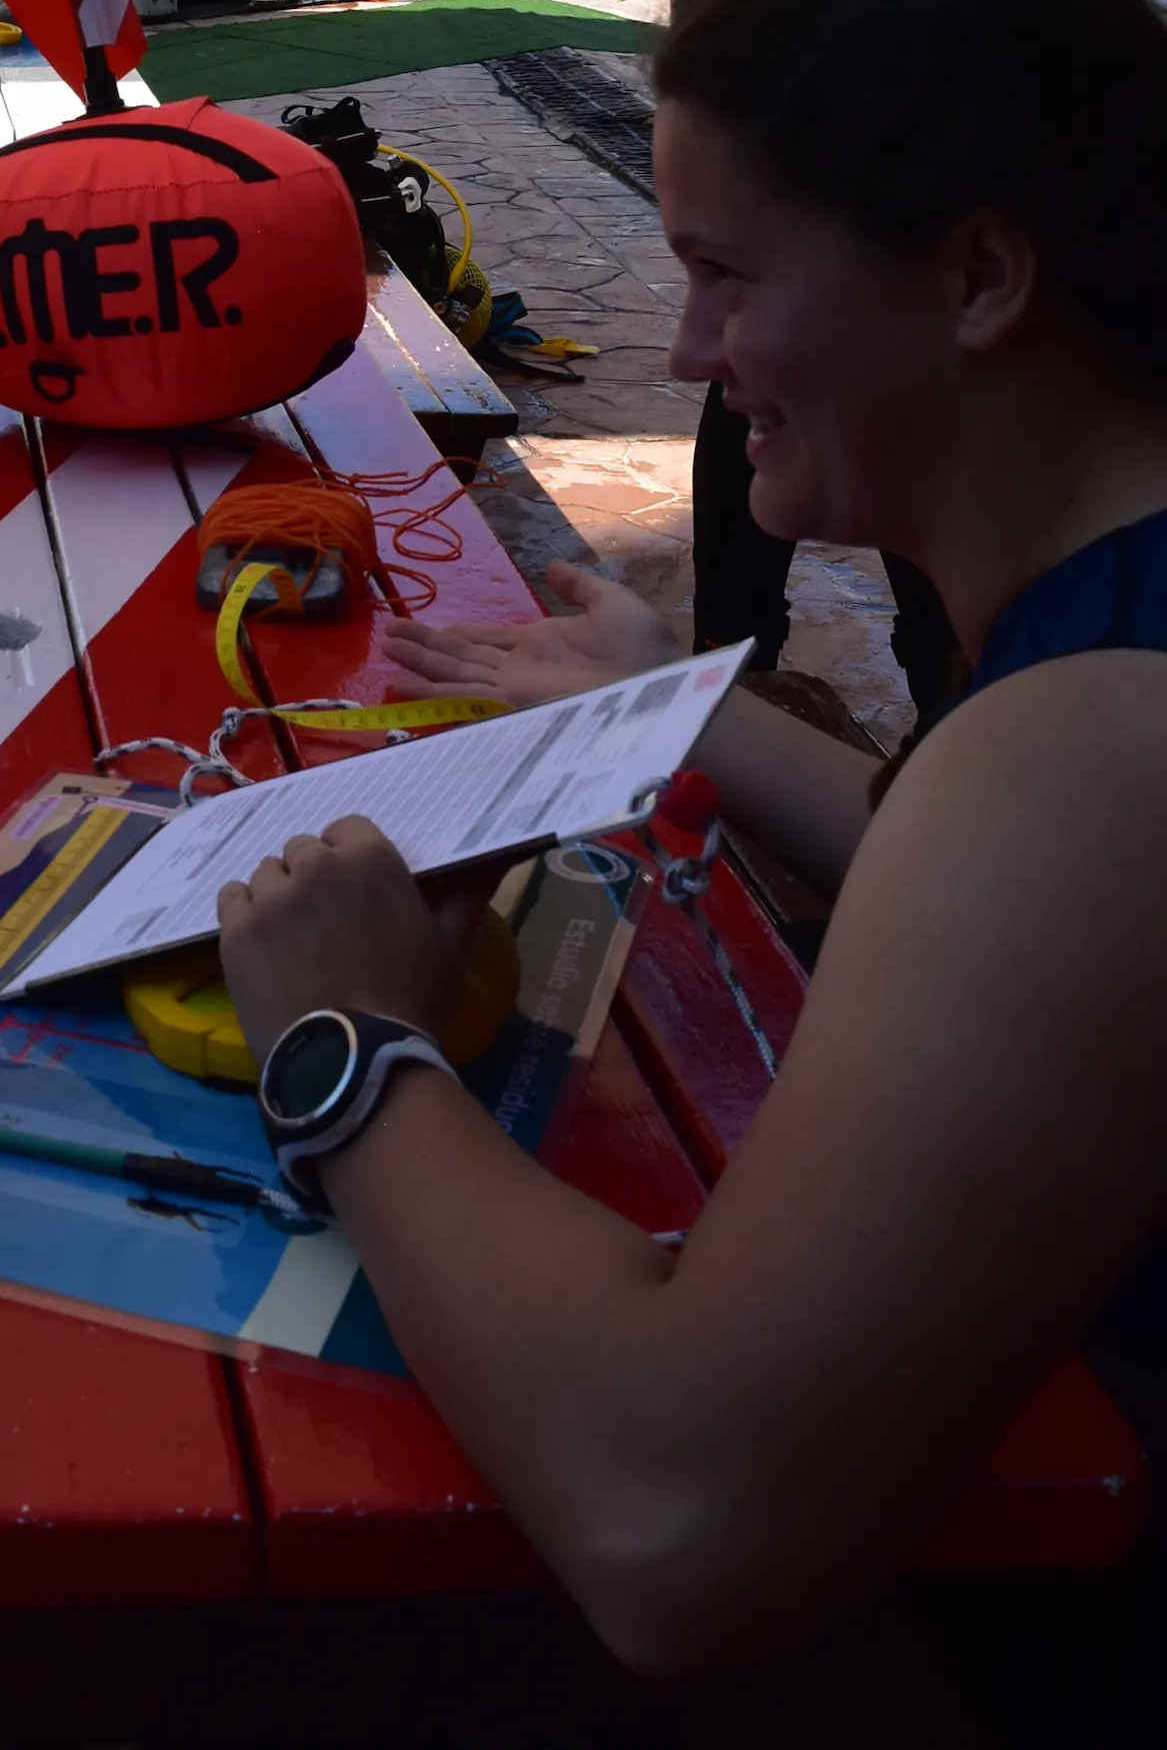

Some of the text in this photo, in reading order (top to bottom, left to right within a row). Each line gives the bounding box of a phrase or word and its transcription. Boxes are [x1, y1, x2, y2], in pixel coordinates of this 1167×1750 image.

[548, 918, 596, 990] Estudio
[522, 994, 563, 1050] sobre
[494, 1053, 540, 1134] residuo
